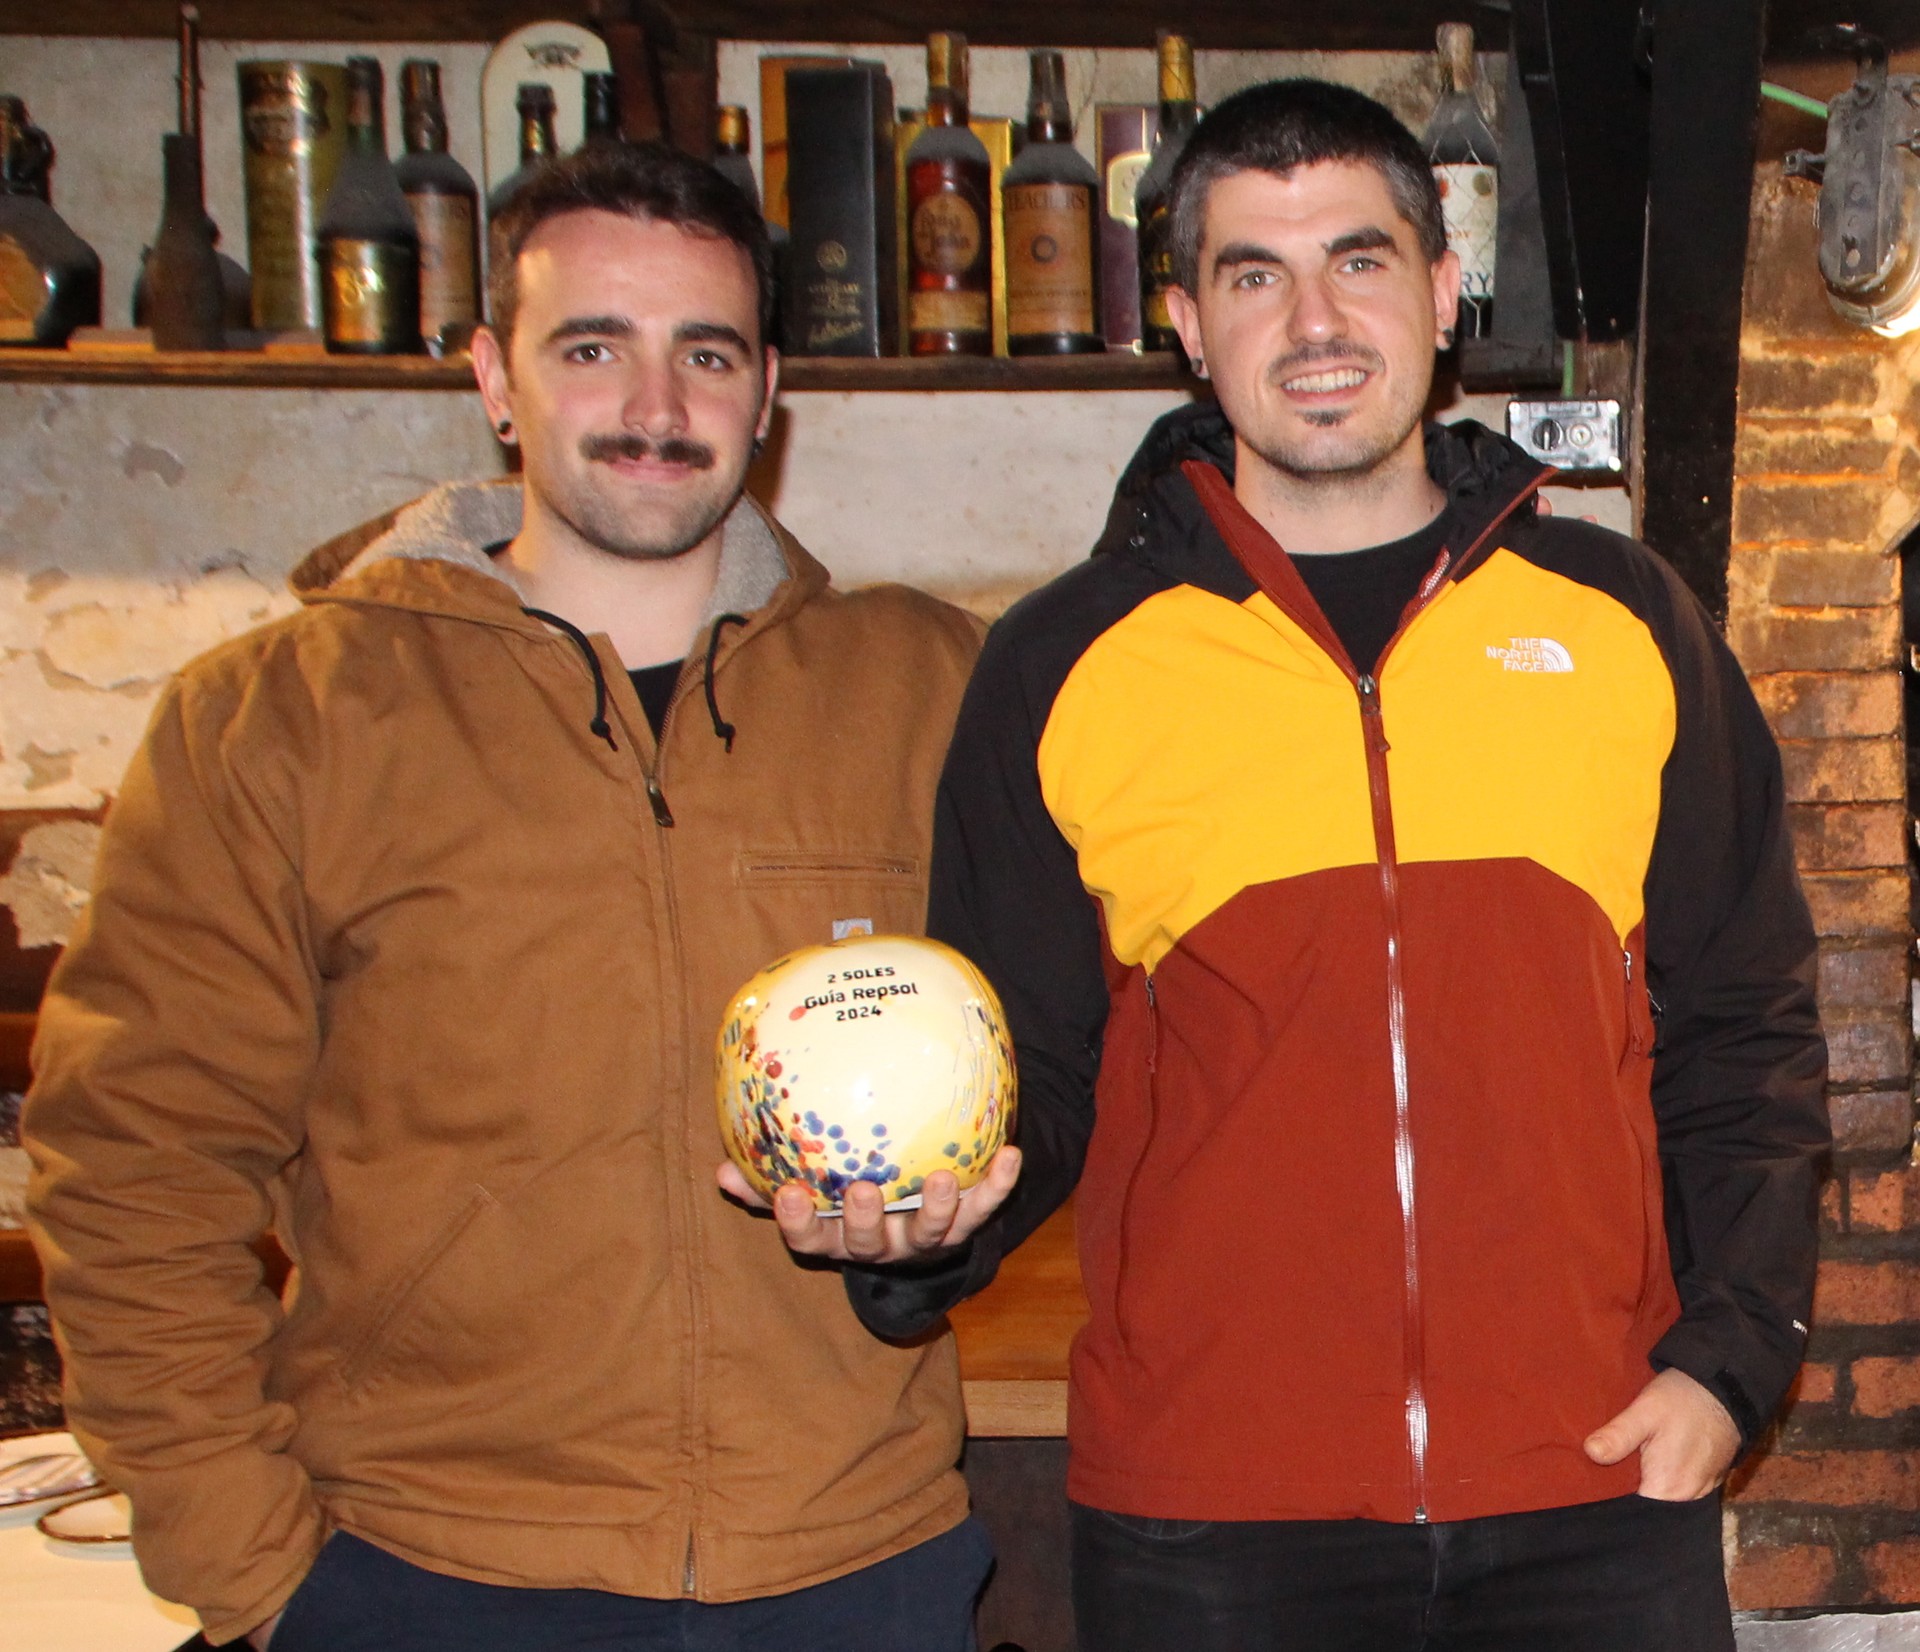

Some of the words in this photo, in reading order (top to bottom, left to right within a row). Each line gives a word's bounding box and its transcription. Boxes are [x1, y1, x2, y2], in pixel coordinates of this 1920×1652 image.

[1509, 637, 1540, 649] THE
[1486, 646, 1541, 661] NORTH
[1503, 660, 1543, 672] FACE
[827, 973, 836, 984] 2
[842, 966, 895, 981] SOLES
[804, 989, 846, 1010] Guía
[852, 982, 919, 1001] Repsol
[836, 1004, 882, 1022] 2024
